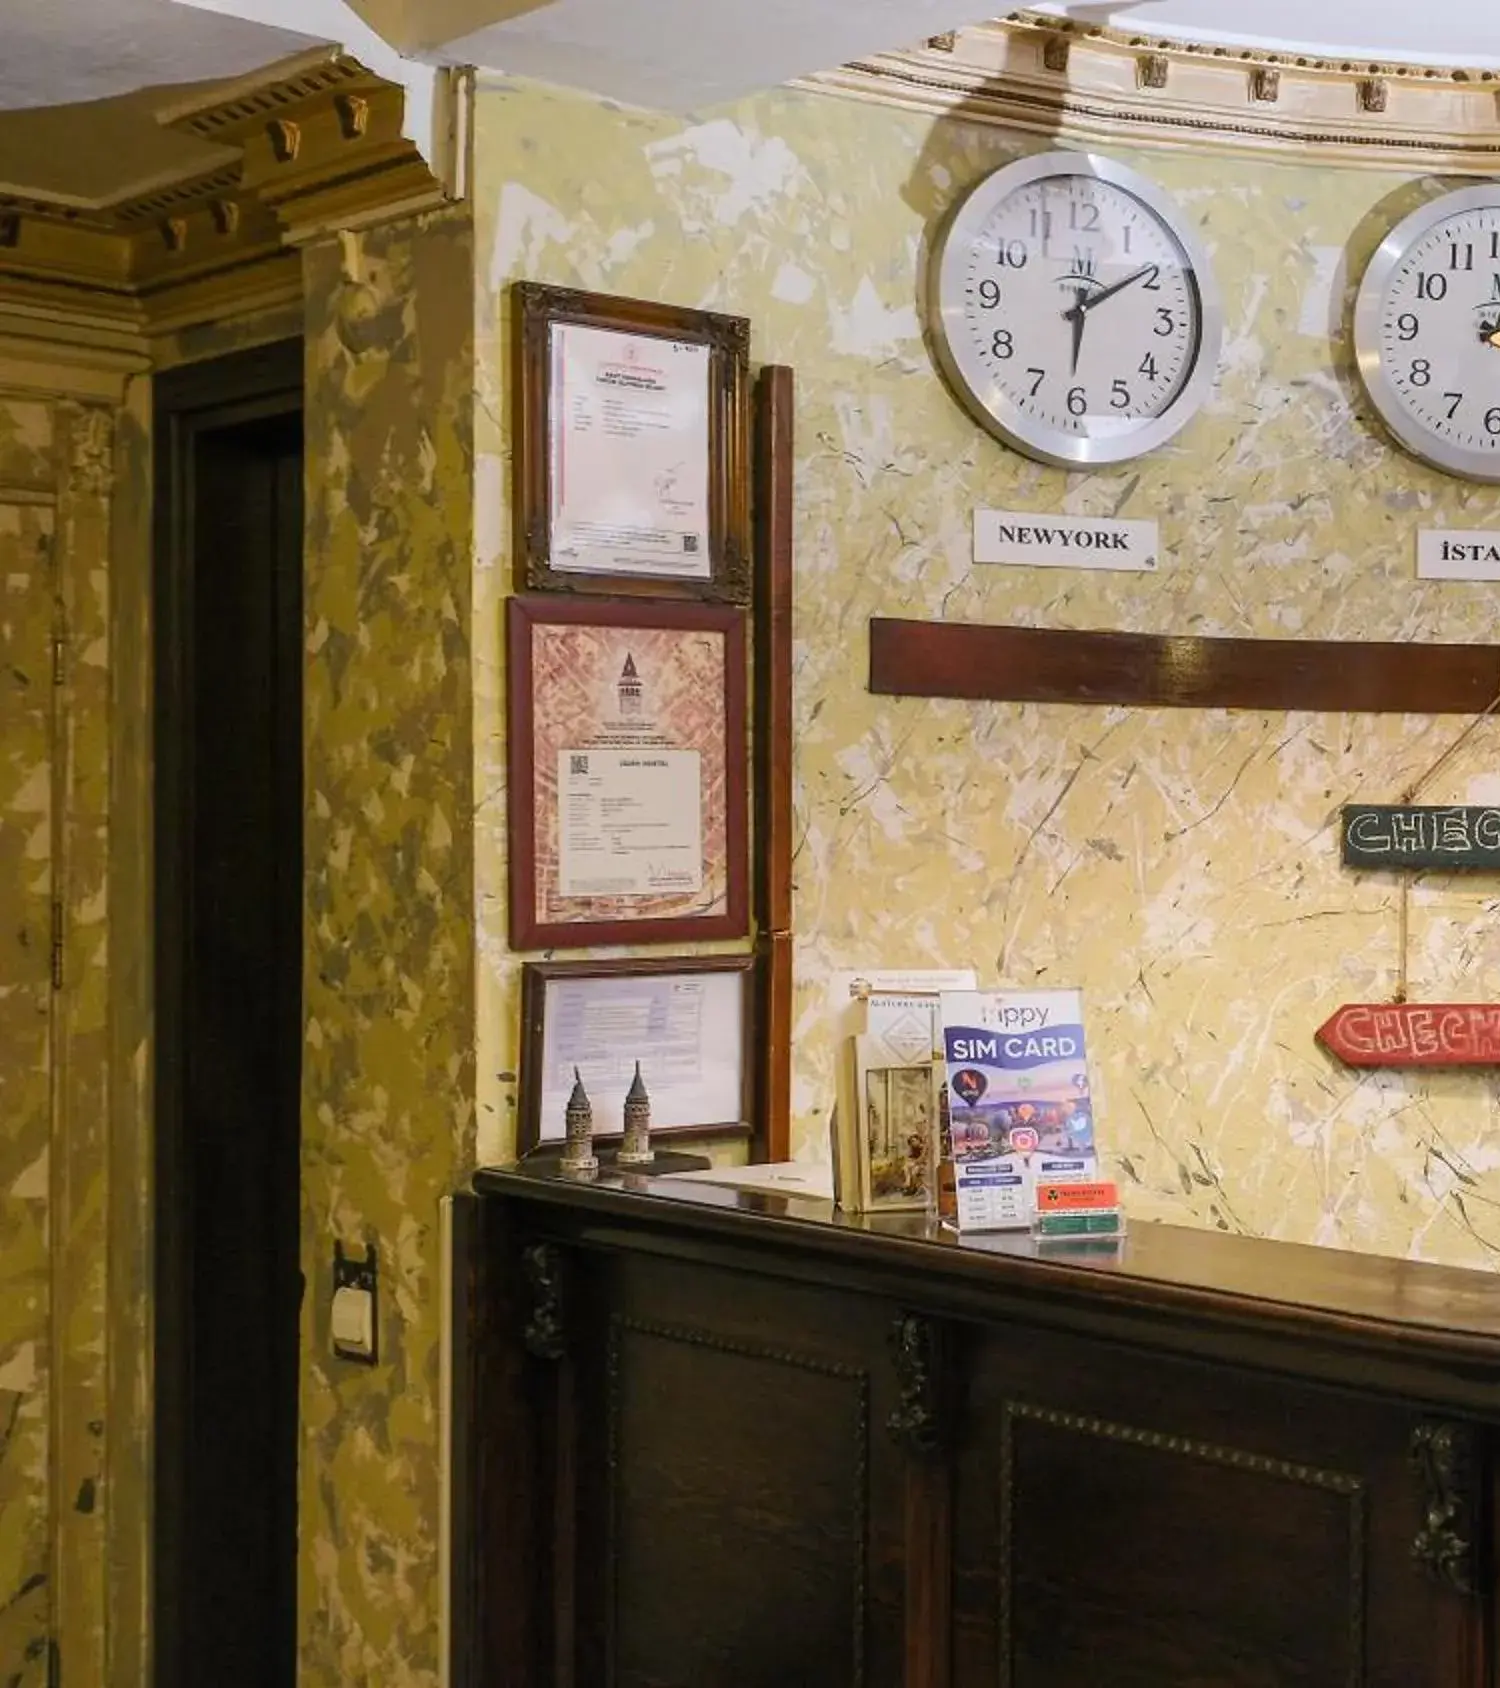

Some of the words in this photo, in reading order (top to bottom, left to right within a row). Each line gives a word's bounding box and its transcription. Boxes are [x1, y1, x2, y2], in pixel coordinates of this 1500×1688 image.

[1068, 202, 1099, 232] 12
[997, 238, 1027, 268] 10
[1121, 226, 1131, 253] 1
[1450, 243, 1473, 271] 11
[1143, 265, 1160, 290] 2
[1417, 272, 1447, 301] 10
[979, 279, 1001, 309] 9
[1153, 308, 1174, 336] 3
[1397, 313, 1419, 341] 9
[992, 329, 1013, 359] 8
[1139, 352, 1158, 380] 4
[1409, 359, 1431, 386] 8
[1026, 368, 1045, 396] 7
[1110, 380, 1130, 408] 5
[1067, 387, 1087, 416] 6
[1443, 393, 1463, 419] 7
[999, 525, 1130, 550] NEWYORK
[953, 1039, 997, 1059] SIM
[1005, 1037, 1076, 1058] CARD
